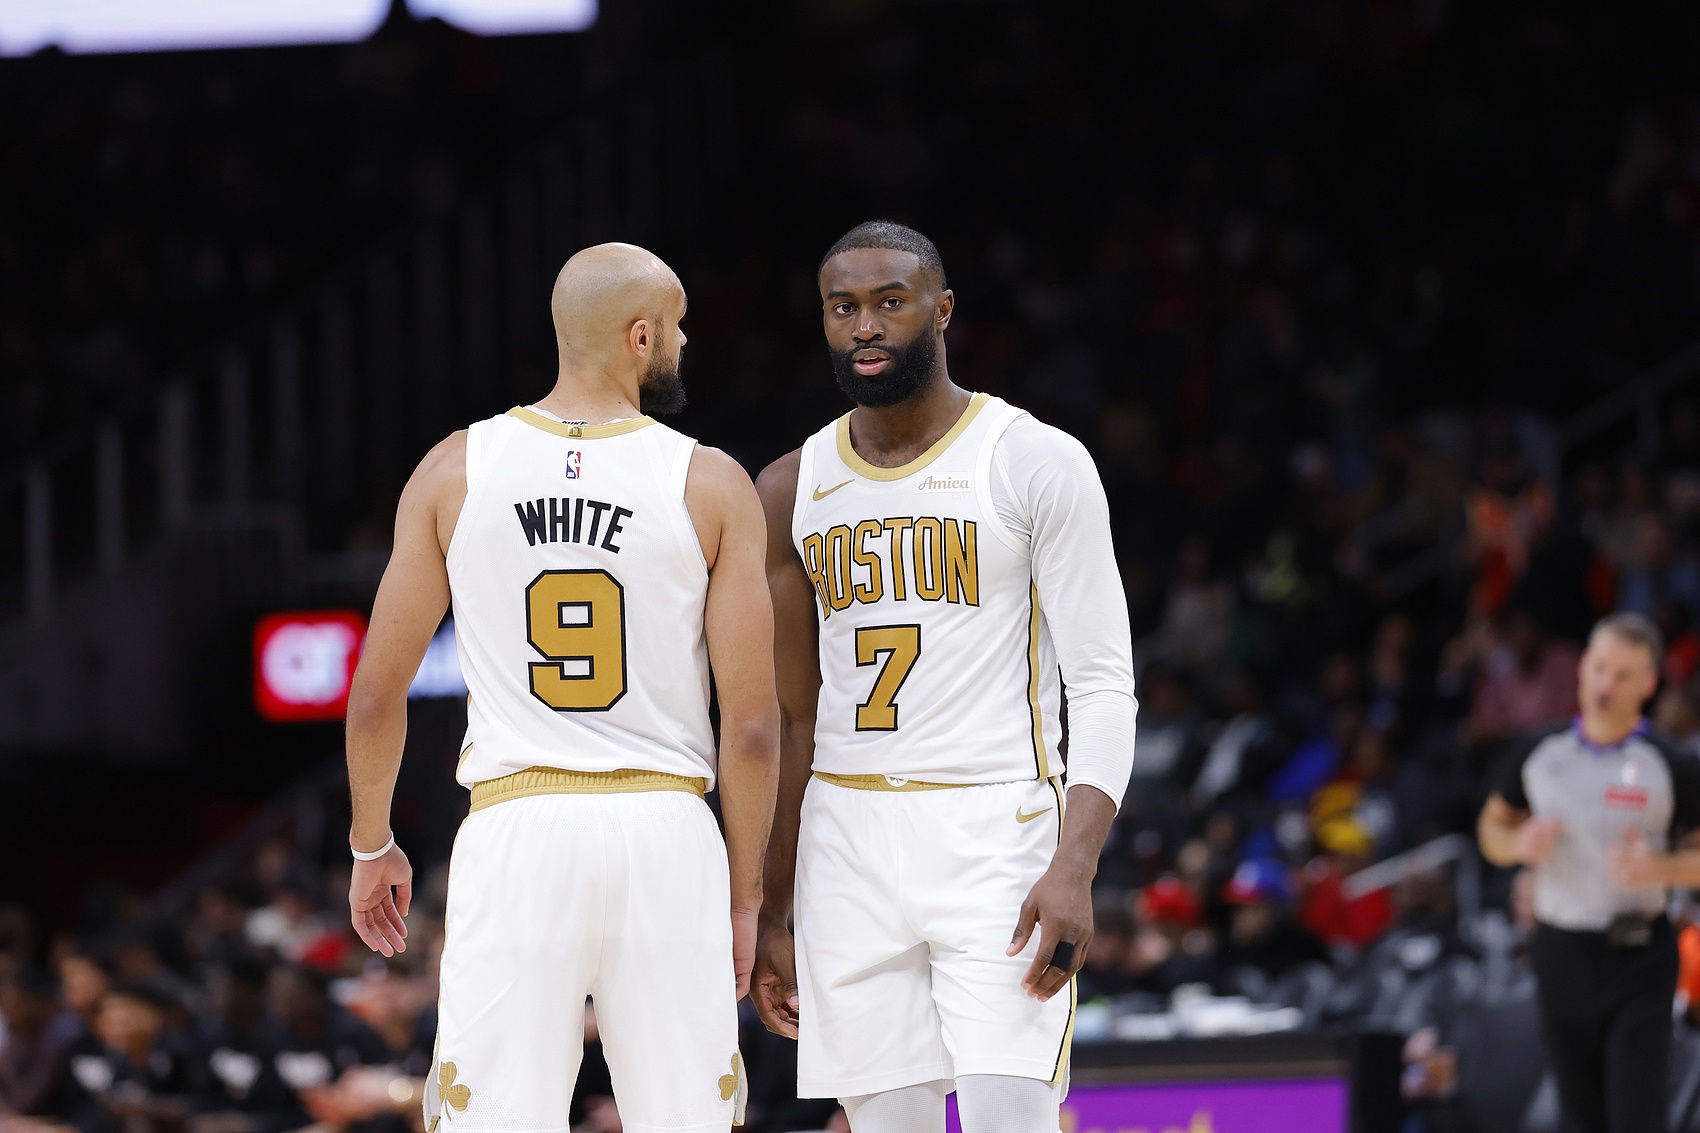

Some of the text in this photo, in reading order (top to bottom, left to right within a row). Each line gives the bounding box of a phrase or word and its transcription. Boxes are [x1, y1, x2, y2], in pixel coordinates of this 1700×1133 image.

[514, 498, 633, 554] WHITE
[919, 475, 969, 491] Amica
[802, 516, 980, 621] BOSTON
[525, 569, 627, 711] 9
[855, 624, 921, 731] 7
